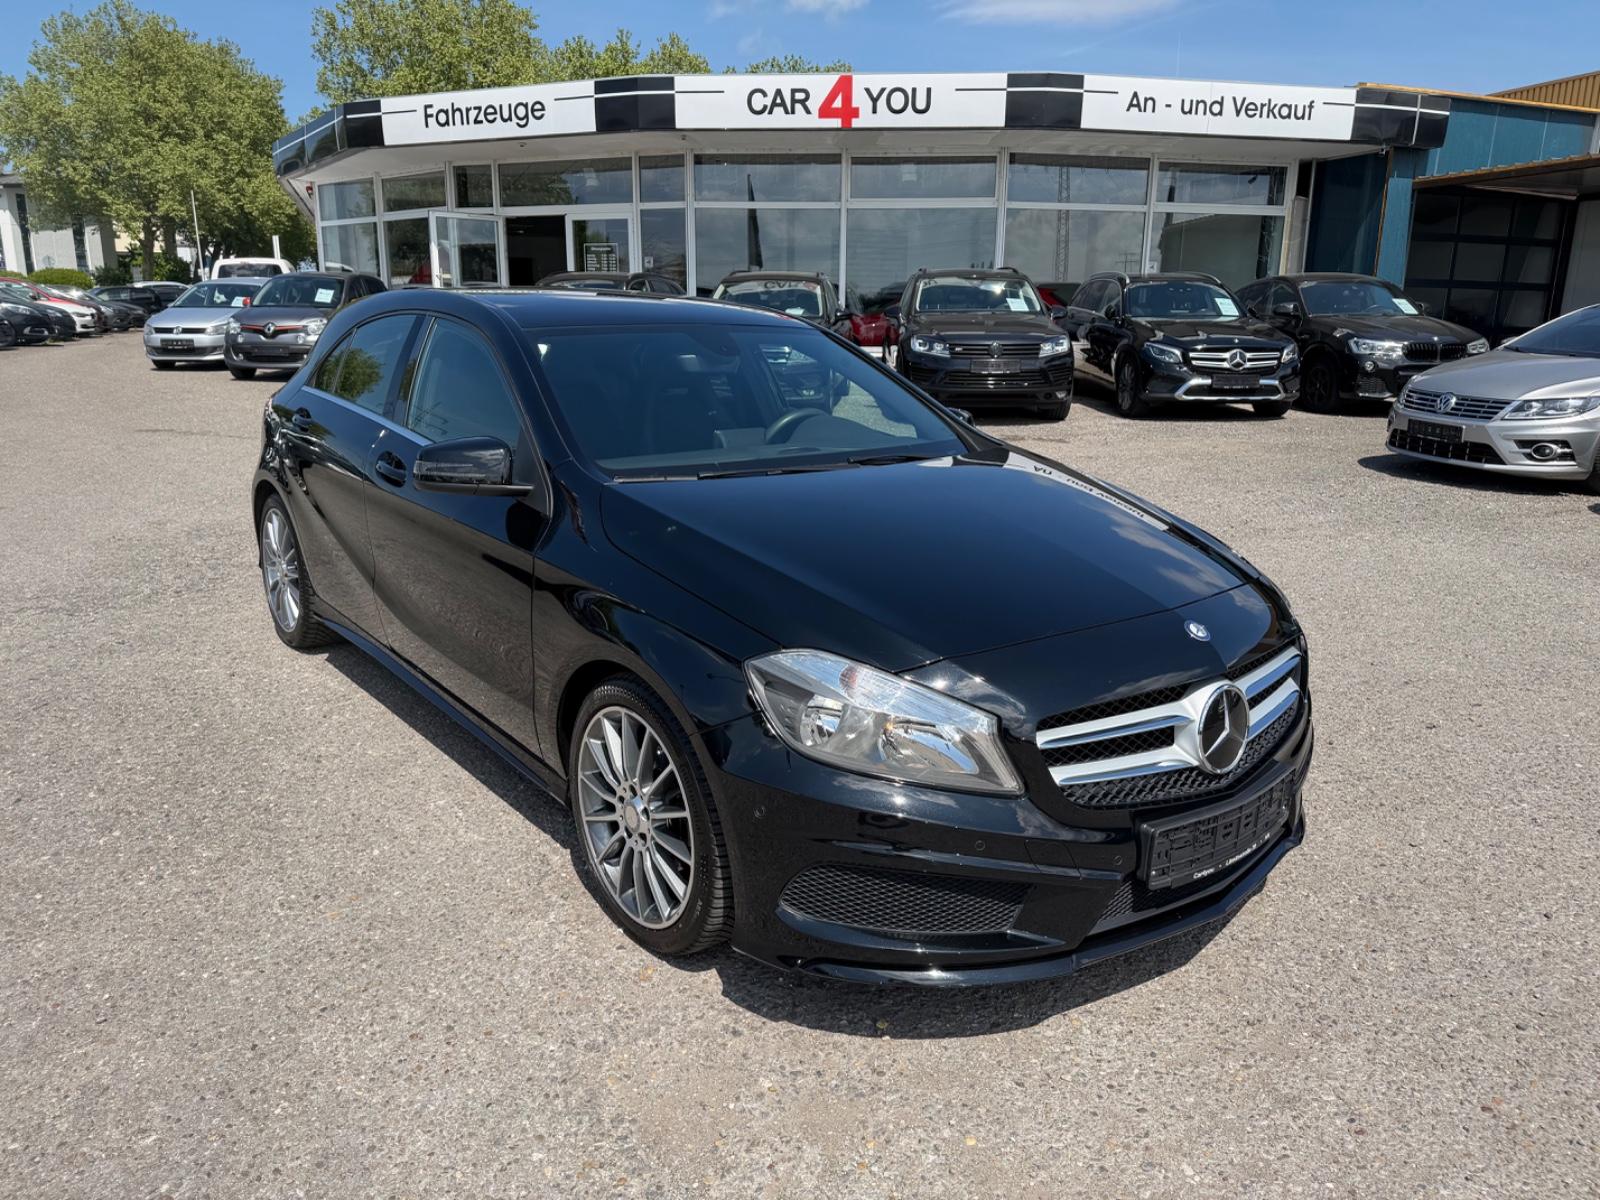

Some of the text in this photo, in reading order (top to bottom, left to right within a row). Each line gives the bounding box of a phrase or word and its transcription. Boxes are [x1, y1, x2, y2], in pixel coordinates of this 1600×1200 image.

[423, 100, 546, 128] Fahrzeuge
[747, 75, 931, 128] CAR 4 YOU
[1125, 91, 1156, 113] An
[1180, 95, 1225, 117] und
[1232, 96, 1315, 121] Verkauf
